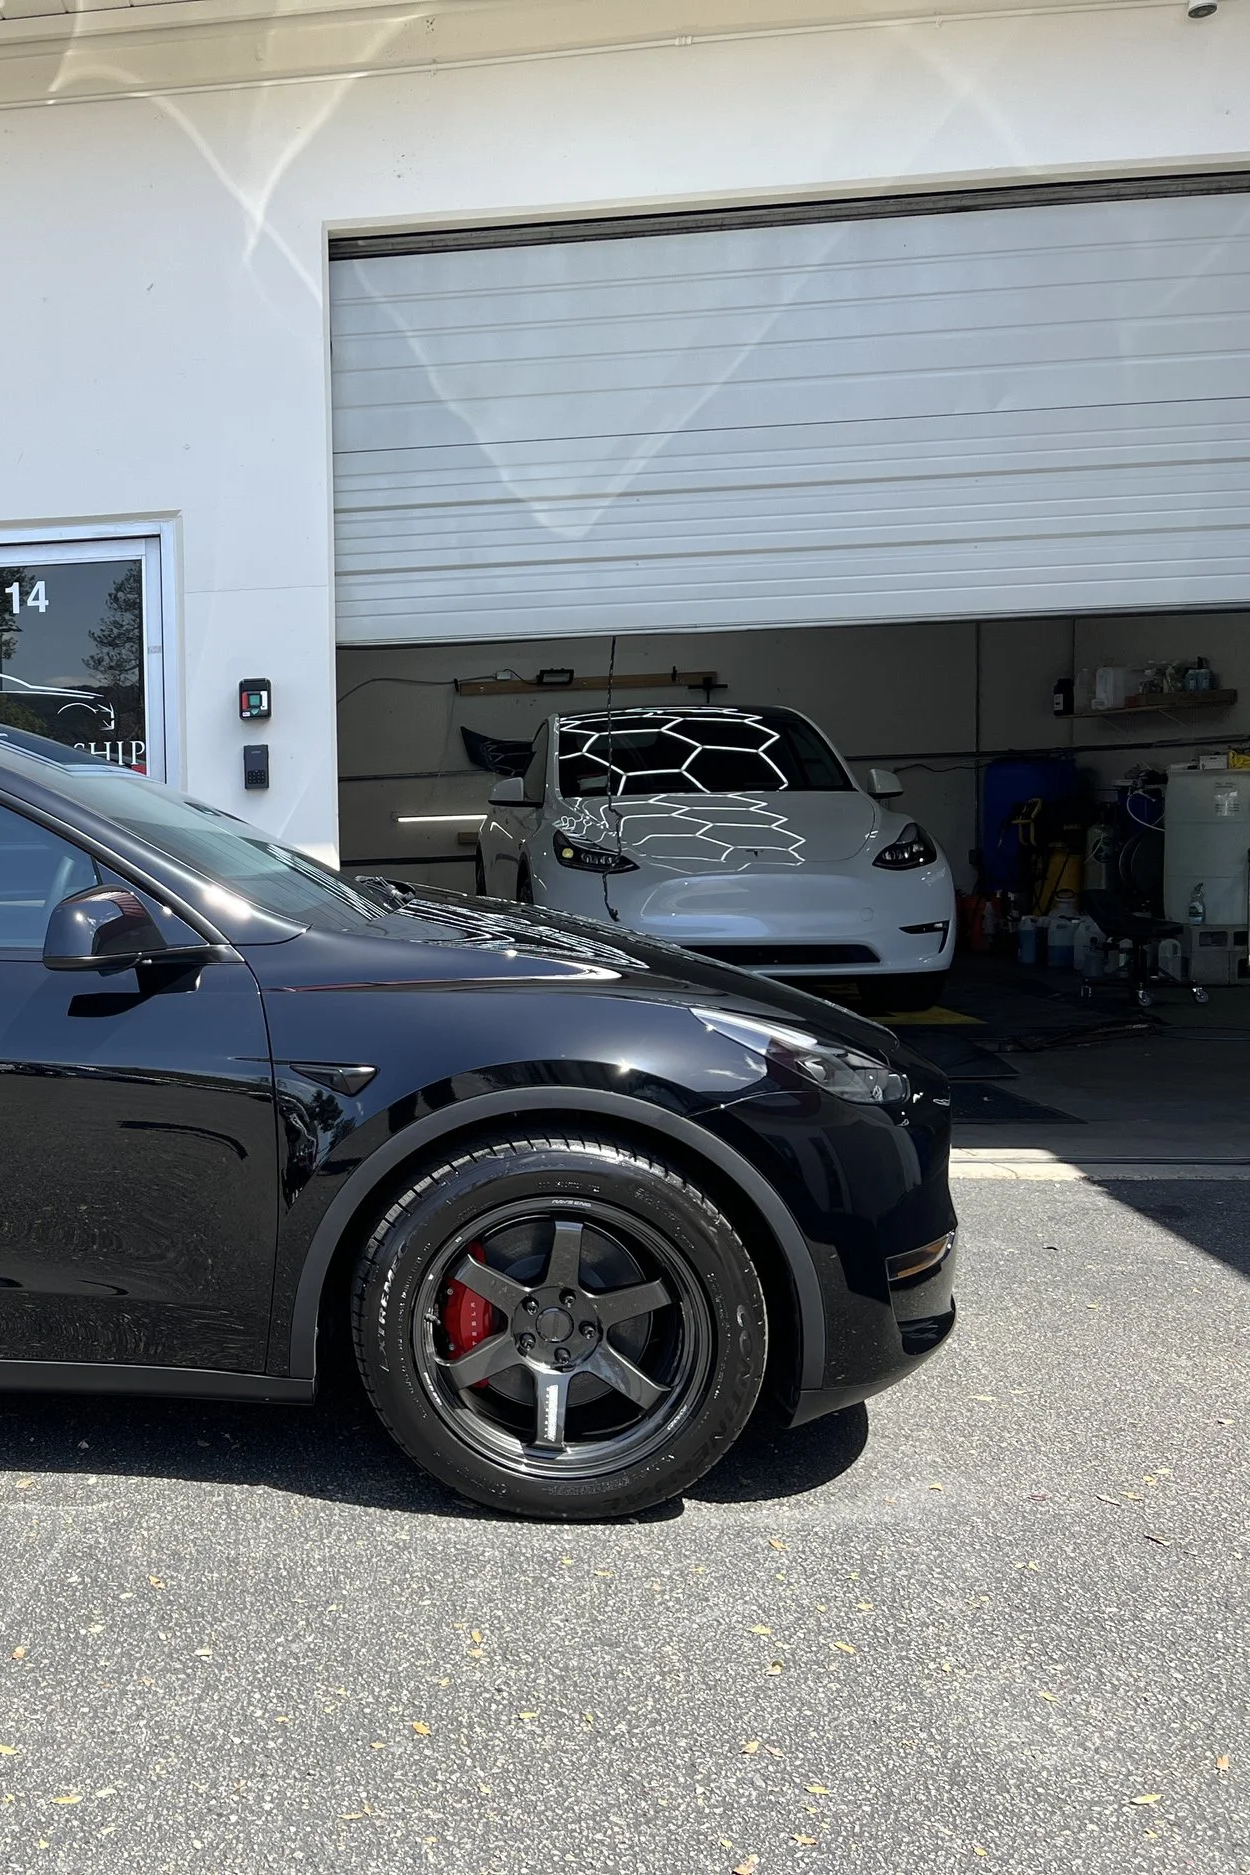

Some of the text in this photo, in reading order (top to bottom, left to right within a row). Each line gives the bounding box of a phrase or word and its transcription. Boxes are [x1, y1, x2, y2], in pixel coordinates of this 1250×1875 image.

[4, 580, 49, 614] 14
[73, 740, 146, 766] HIP
[470, 1302, 479, 1346] TESLA
